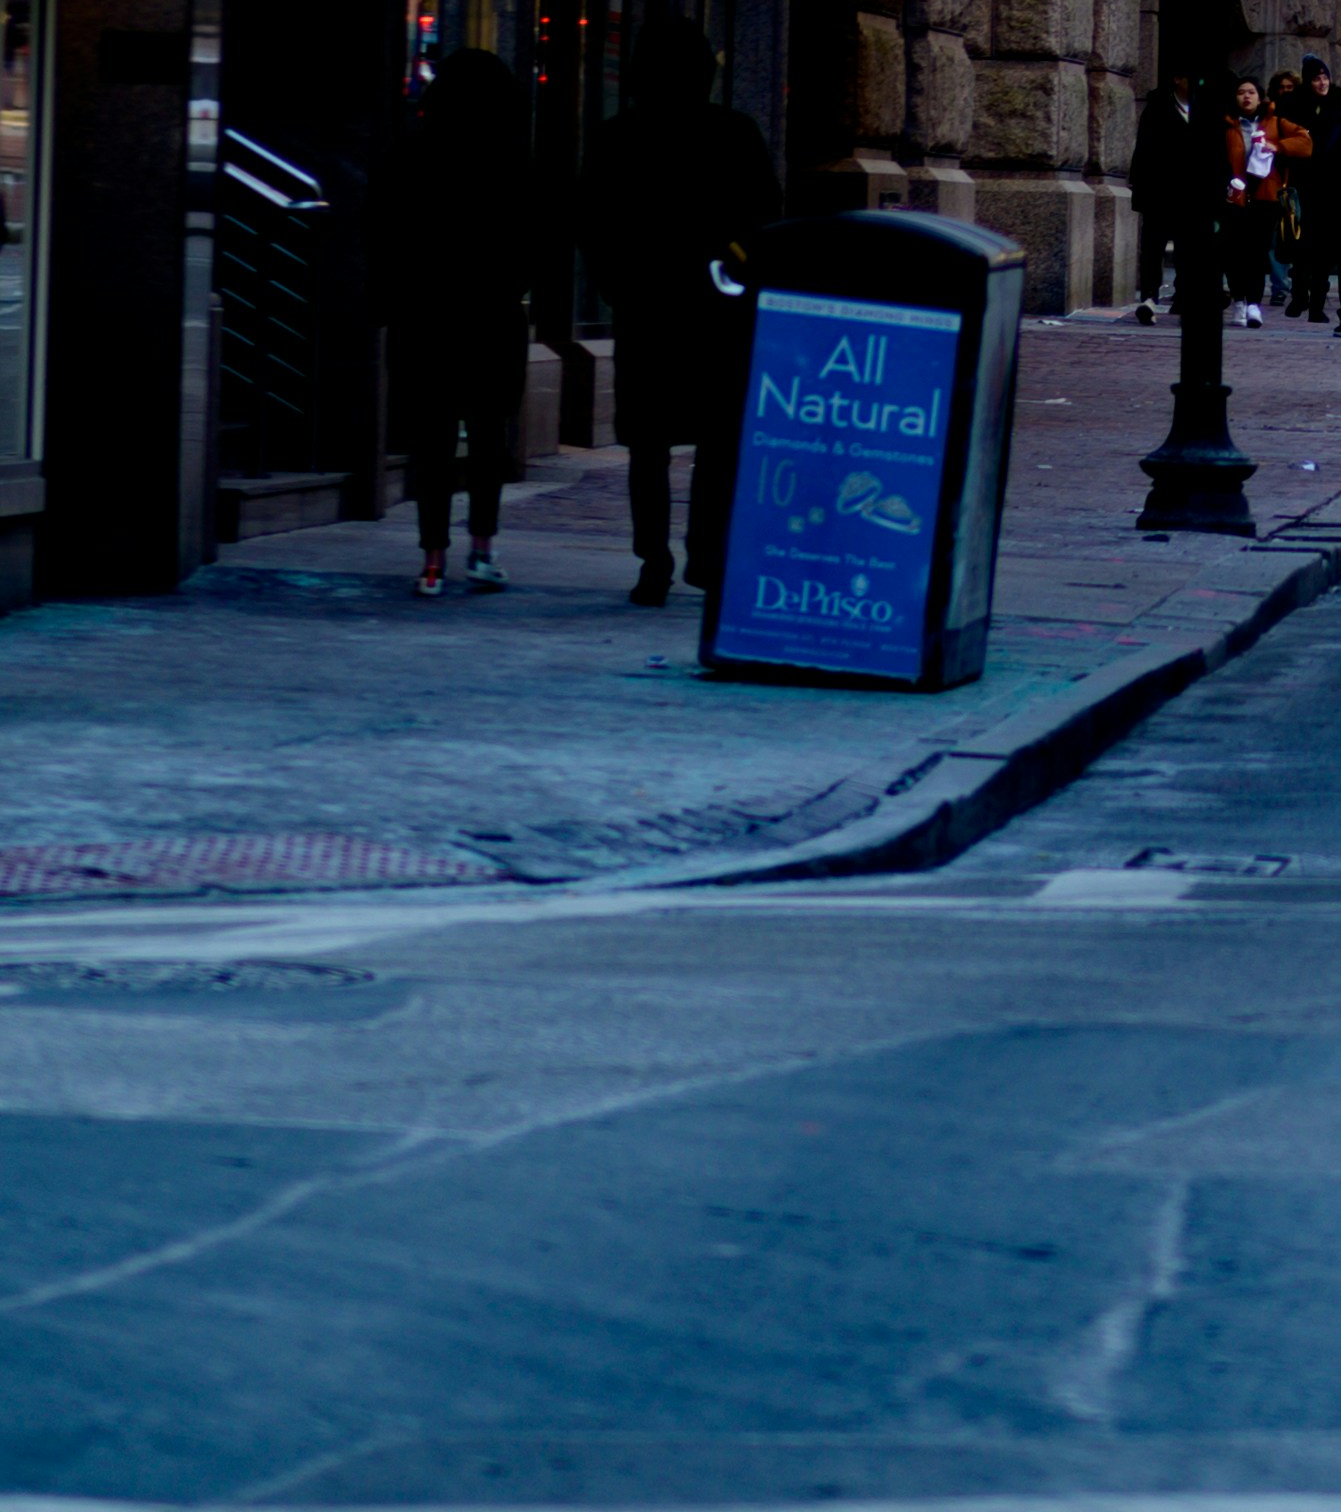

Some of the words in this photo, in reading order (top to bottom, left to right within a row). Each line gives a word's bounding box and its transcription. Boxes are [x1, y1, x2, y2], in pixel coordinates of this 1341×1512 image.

[819, 334, 888, 386] All
[757, 371, 942, 439] Natural
[753, 431, 828, 454] Diamonds
[832, 441, 845, 456] &
[849, 442, 935, 466] Gemstones
[765, 544, 787, 557] She
[755, 575, 893, 623] DePrisco
